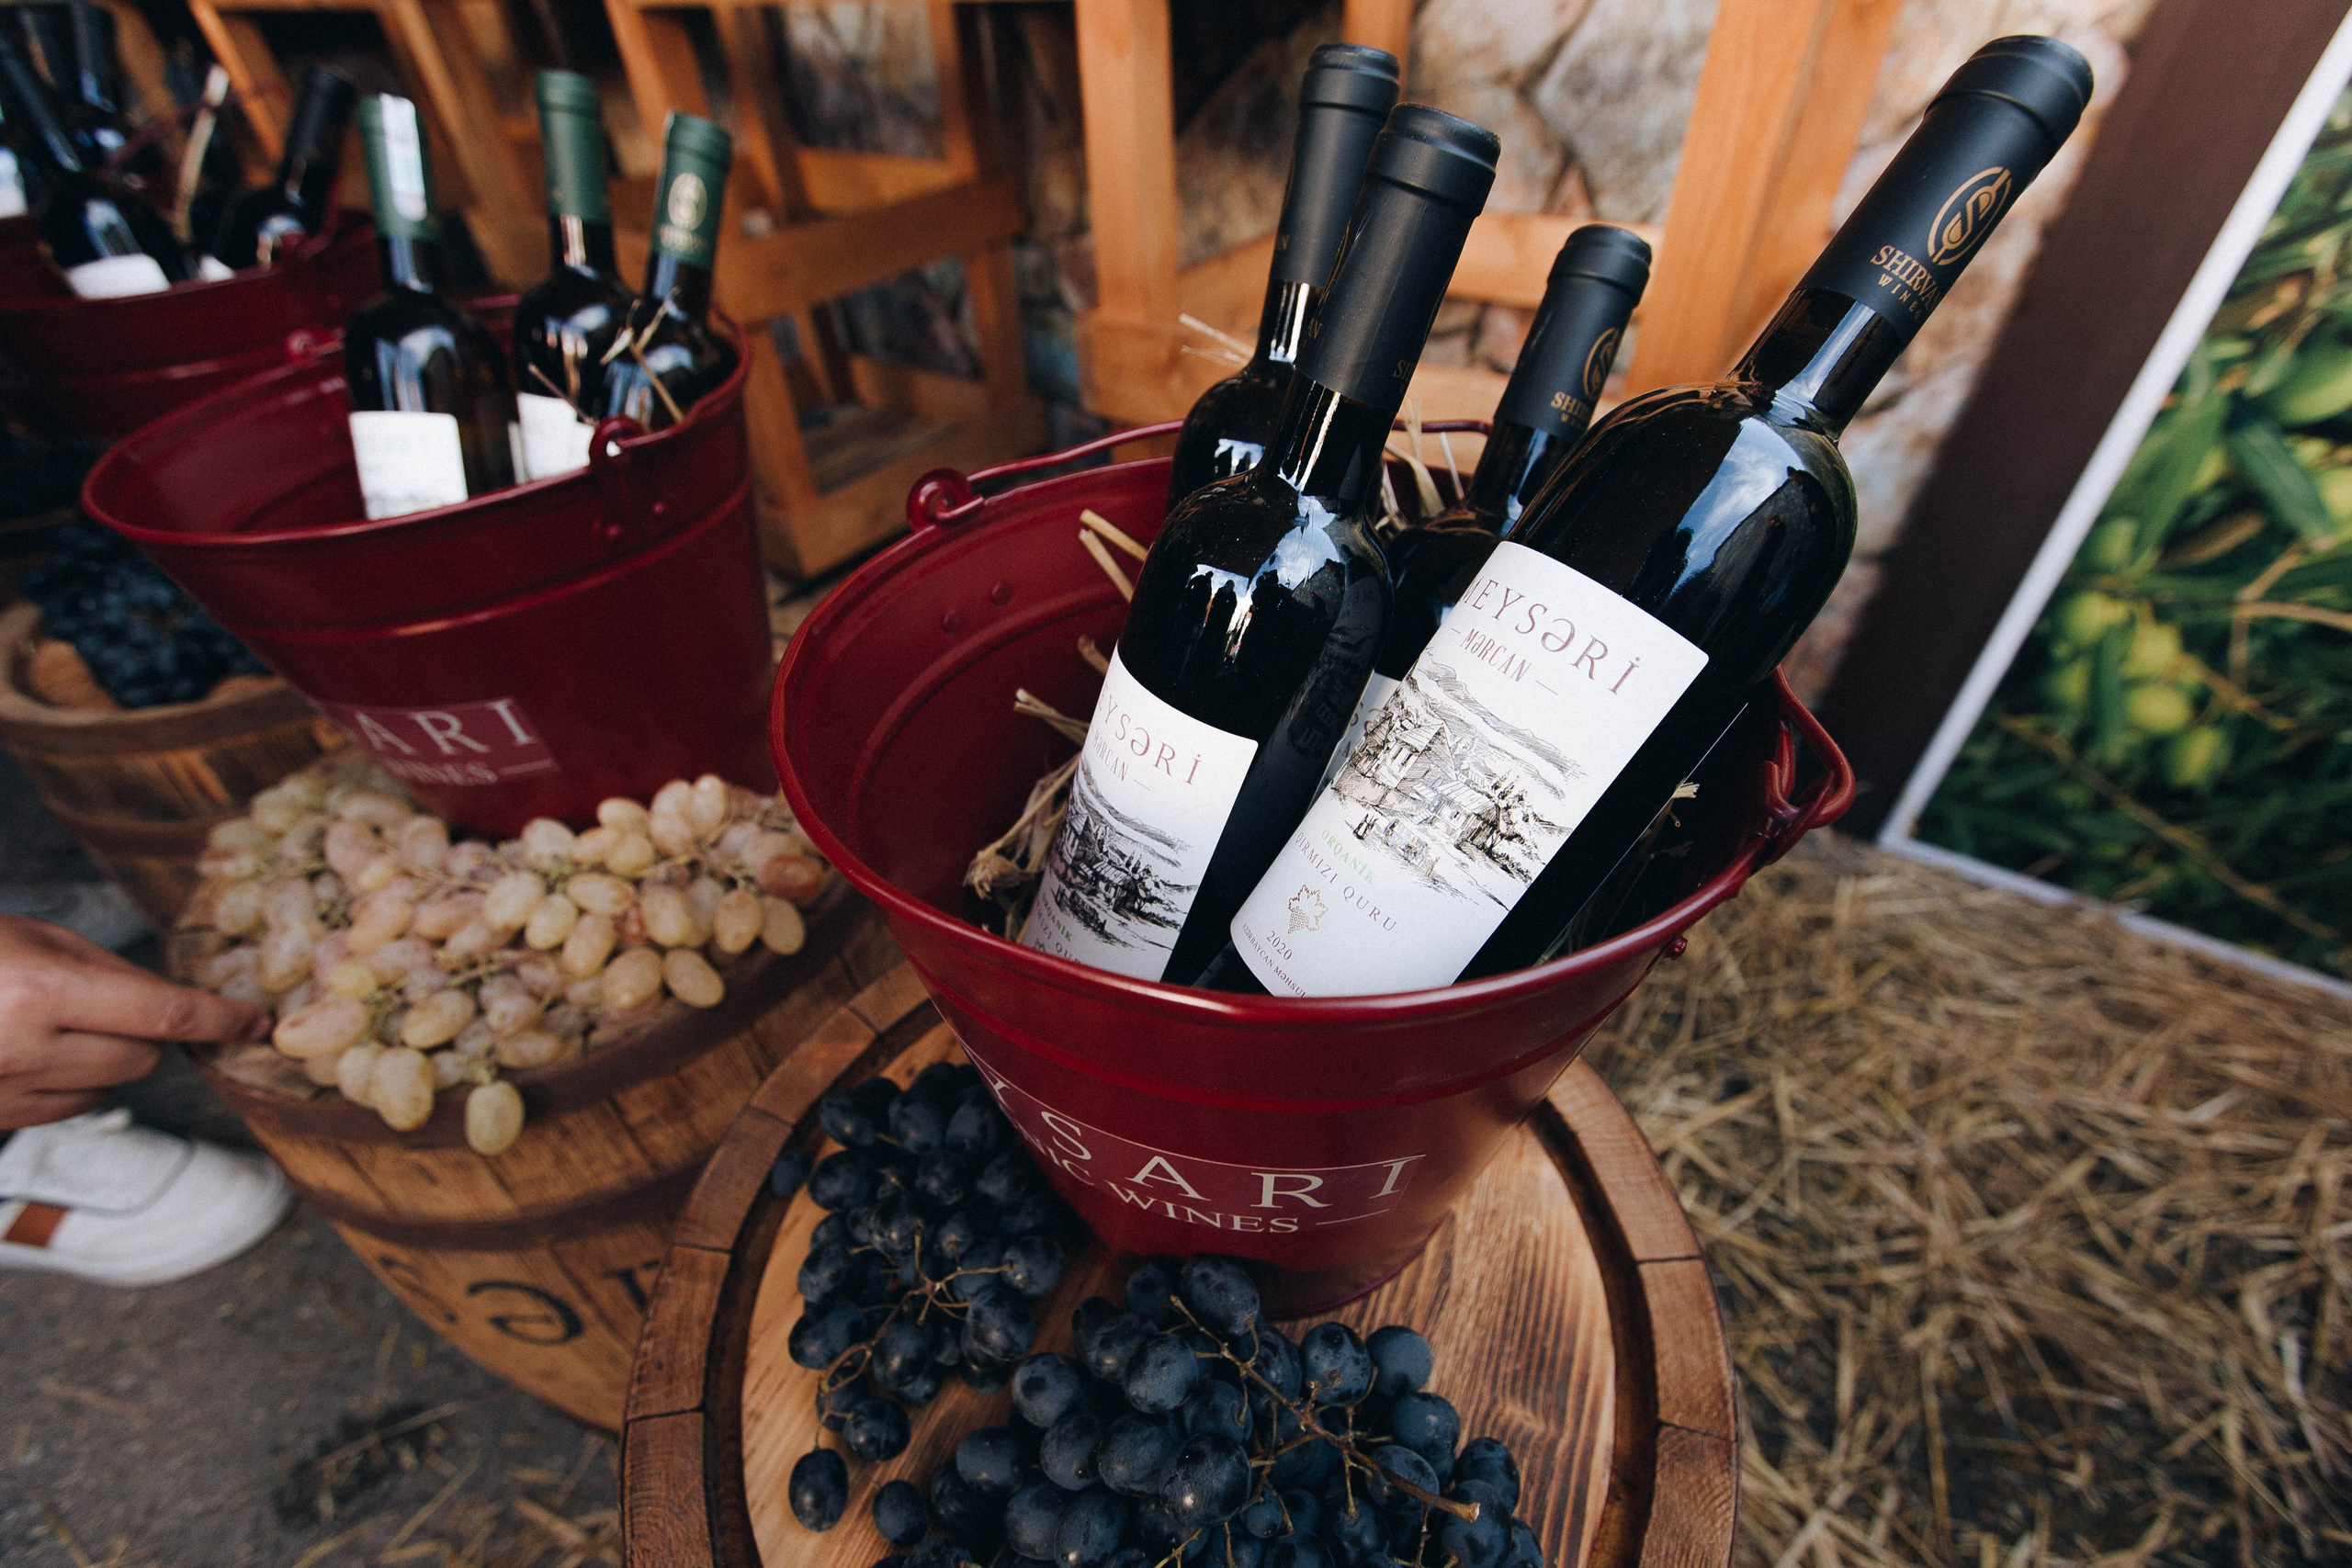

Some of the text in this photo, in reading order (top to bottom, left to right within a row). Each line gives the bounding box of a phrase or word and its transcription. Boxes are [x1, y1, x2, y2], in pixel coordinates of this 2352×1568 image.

[1460, 627, 1532, 682] MƏRCAN
[355, 698, 537, 756] ARI
[1295, 831, 1397, 931] QIRMIZI QURU
[1266, 930, 1294, 962] 2020
[1103, 1179, 1299, 1234] WINES
